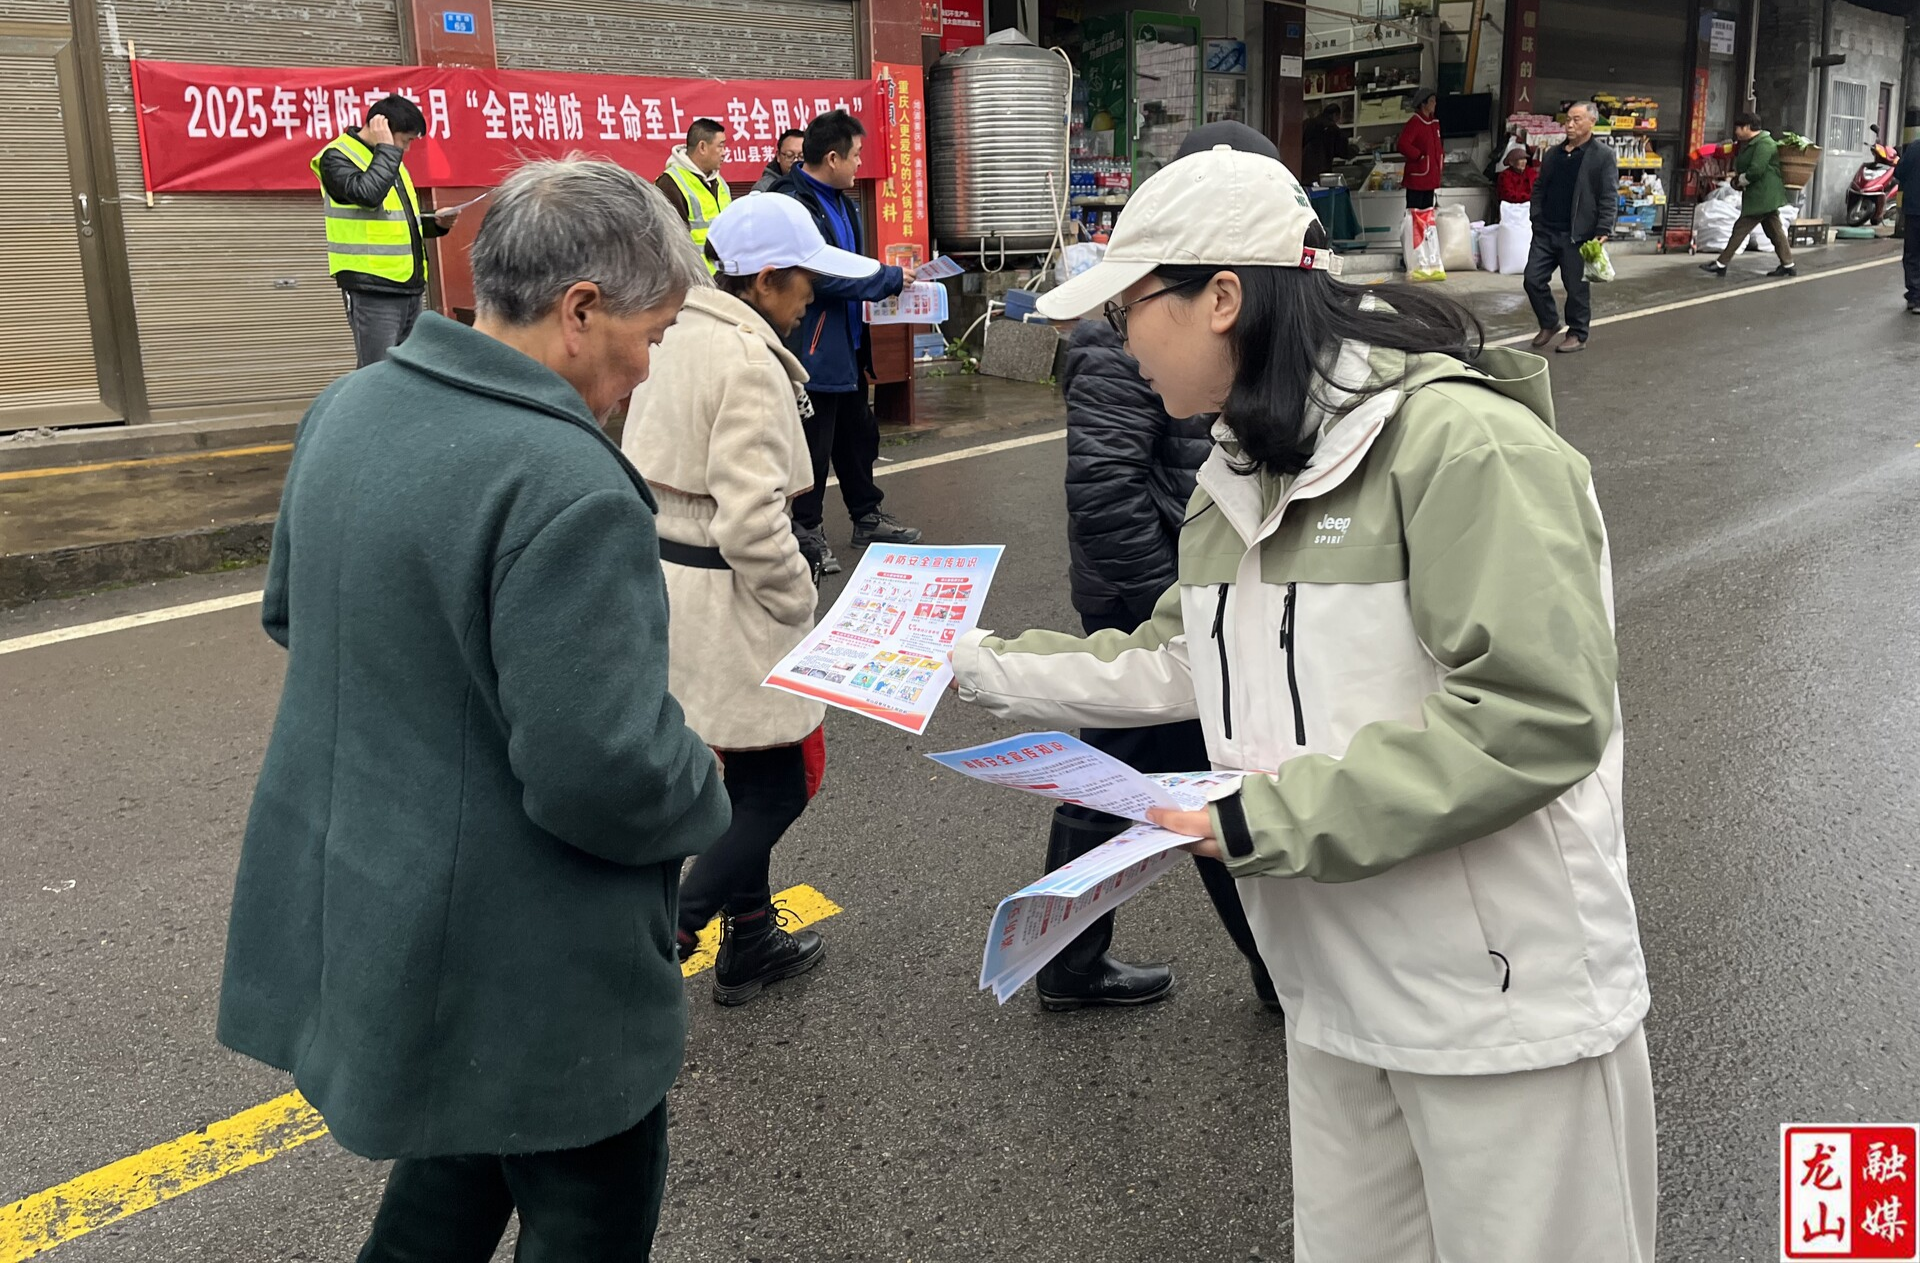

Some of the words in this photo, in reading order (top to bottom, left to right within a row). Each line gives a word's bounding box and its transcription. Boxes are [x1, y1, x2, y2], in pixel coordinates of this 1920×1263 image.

[454, 22, 466, 31] 65
[184, 84, 451, 141] 2025年消防月
[898, 80, 914, 238] 重庆人更爱吃的火锅底料
[1316, 513, 1351, 533] Jeep
[882, 553, 980, 569] 消防安全宣传知识
[960, 741, 1068, 770] 消防安全宣传知识
